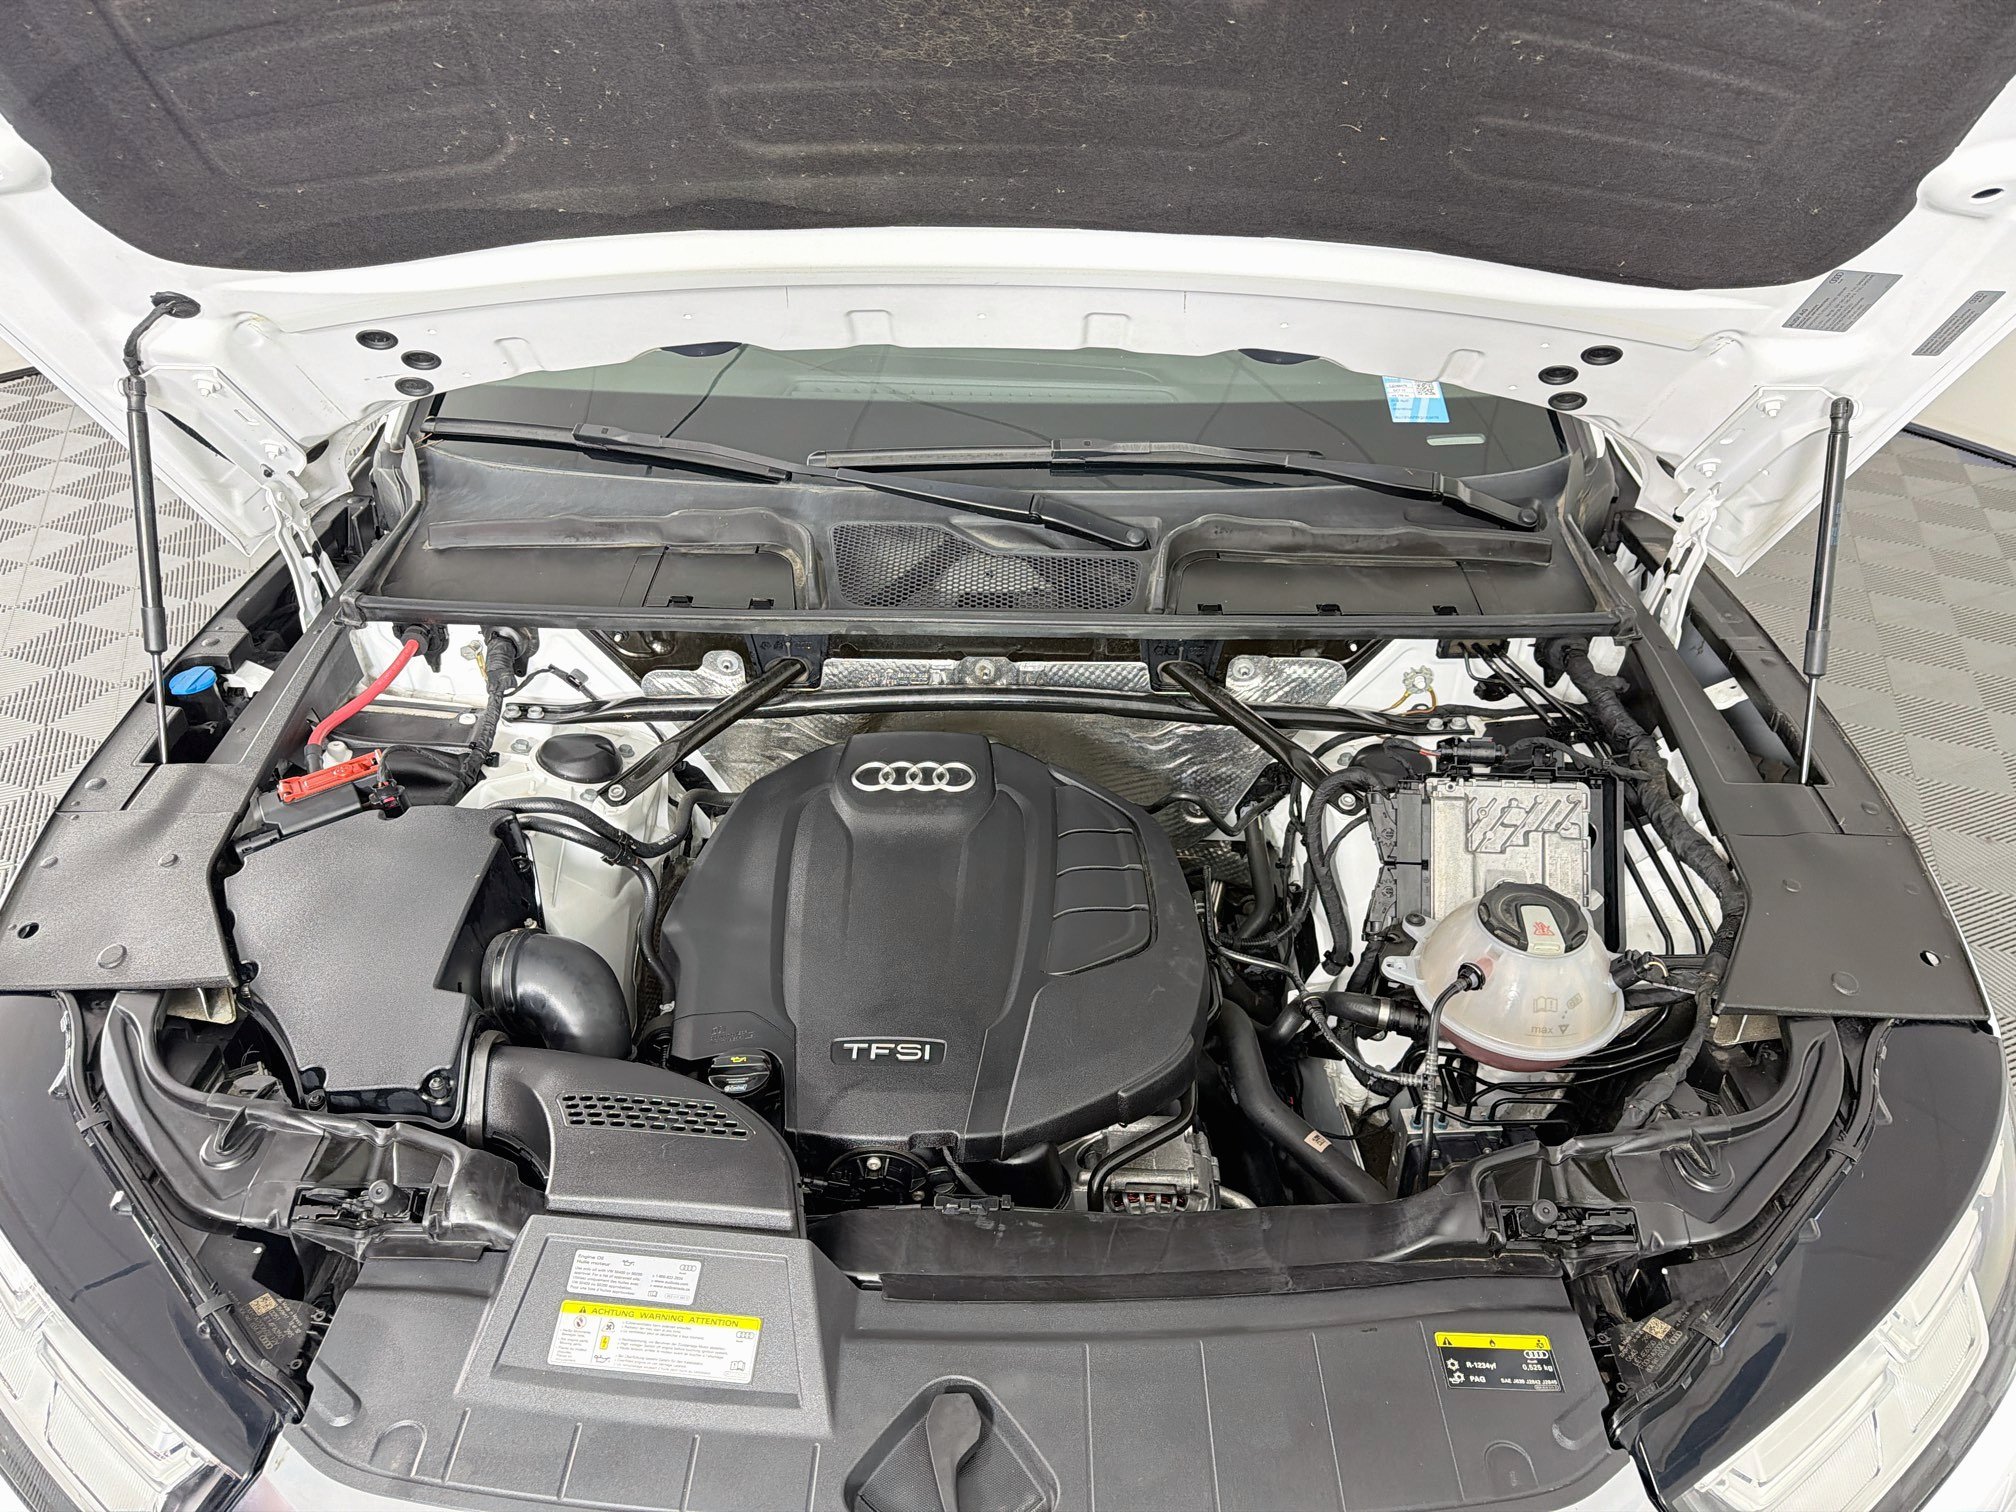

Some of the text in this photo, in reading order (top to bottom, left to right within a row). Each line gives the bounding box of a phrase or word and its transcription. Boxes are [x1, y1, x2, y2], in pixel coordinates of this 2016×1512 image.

[1531, 1025, 1553, 1034] max
[843, 1043, 931, 1061] TFSI
[591, 1307, 739, 1328] ACHTUNG WARNING ATTENTION
[1466, 1361, 1554, 1372] R-1234yf 0,525 kg
[1469, 1375, 1487, 1383] PAG
